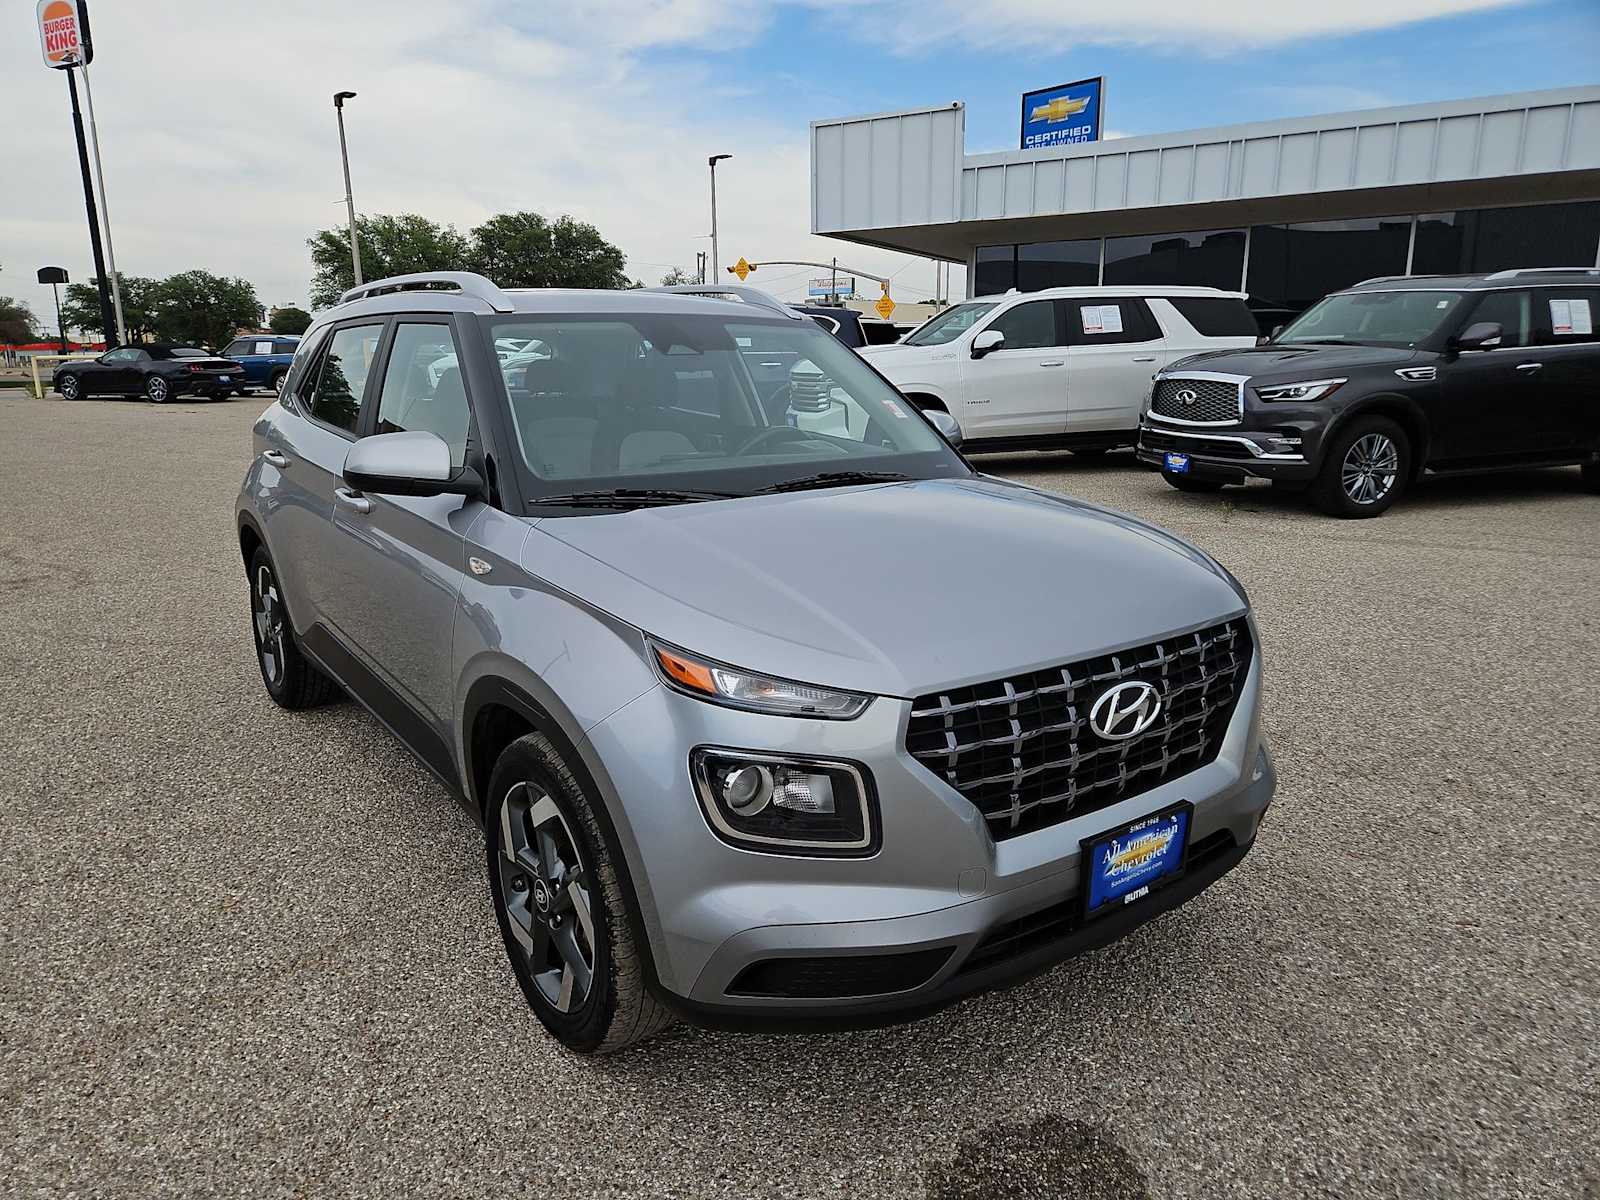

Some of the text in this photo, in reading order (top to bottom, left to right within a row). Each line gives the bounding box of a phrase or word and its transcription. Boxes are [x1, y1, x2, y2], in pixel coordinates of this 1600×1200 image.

[44, 18, 75, 34] BURGER
[46, 31, 77, 52] KING
[1026, 125, 1091, 144] CERTIFIED
[1129, 820, 1146, 833] SINCE
[1102, 824, 1178, 864] All American
[1111, 844, 1167, 876] Chevrolet
